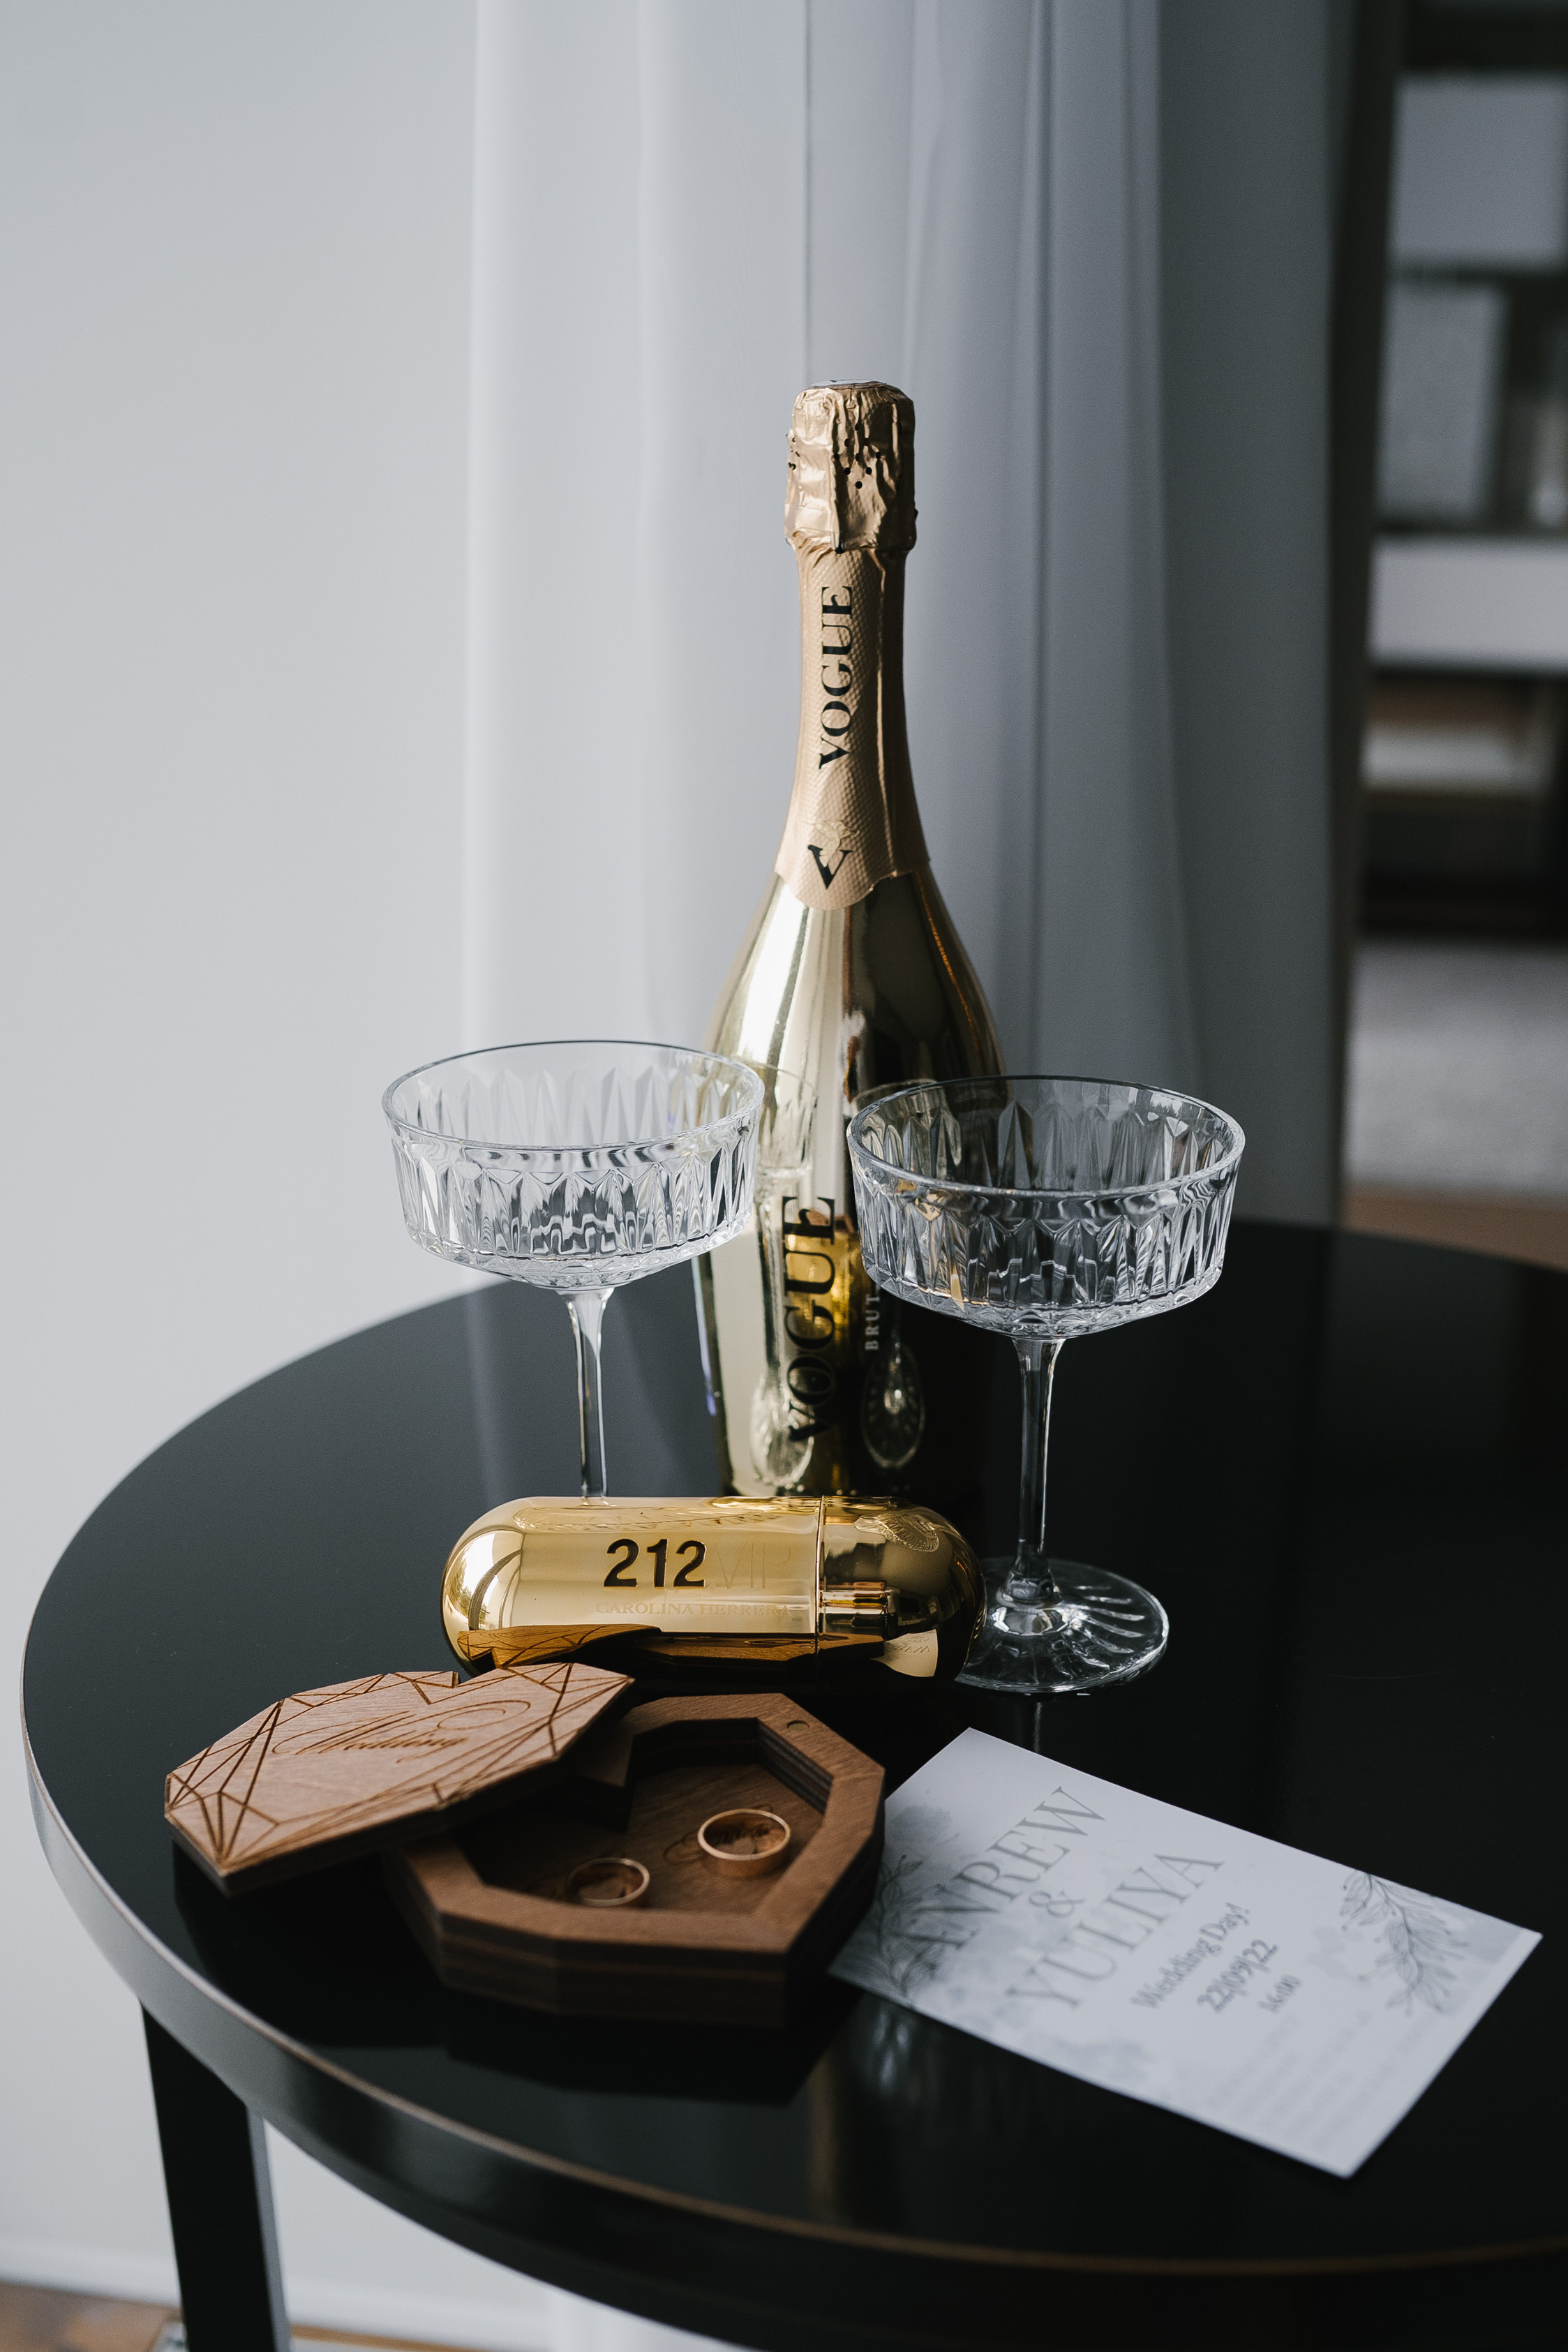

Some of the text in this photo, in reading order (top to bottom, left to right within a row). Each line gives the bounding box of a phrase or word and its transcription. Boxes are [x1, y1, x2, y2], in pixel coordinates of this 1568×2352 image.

[818, 585, 854, 770] VOGUE
[782, 1195, 836, 1442] VOGUE
[865, 1293, 880, 1350] BRUT
[603, 1538, 707, 1588] 212
[596, 1602, 793, 1617] CAROLINA HERRERA
[1003, 1853, 1225, 2010] YULIYA
[1028, 1889, 1085, 1918] &
[1128, 1902, 1250, 2009] Wedding Day!
